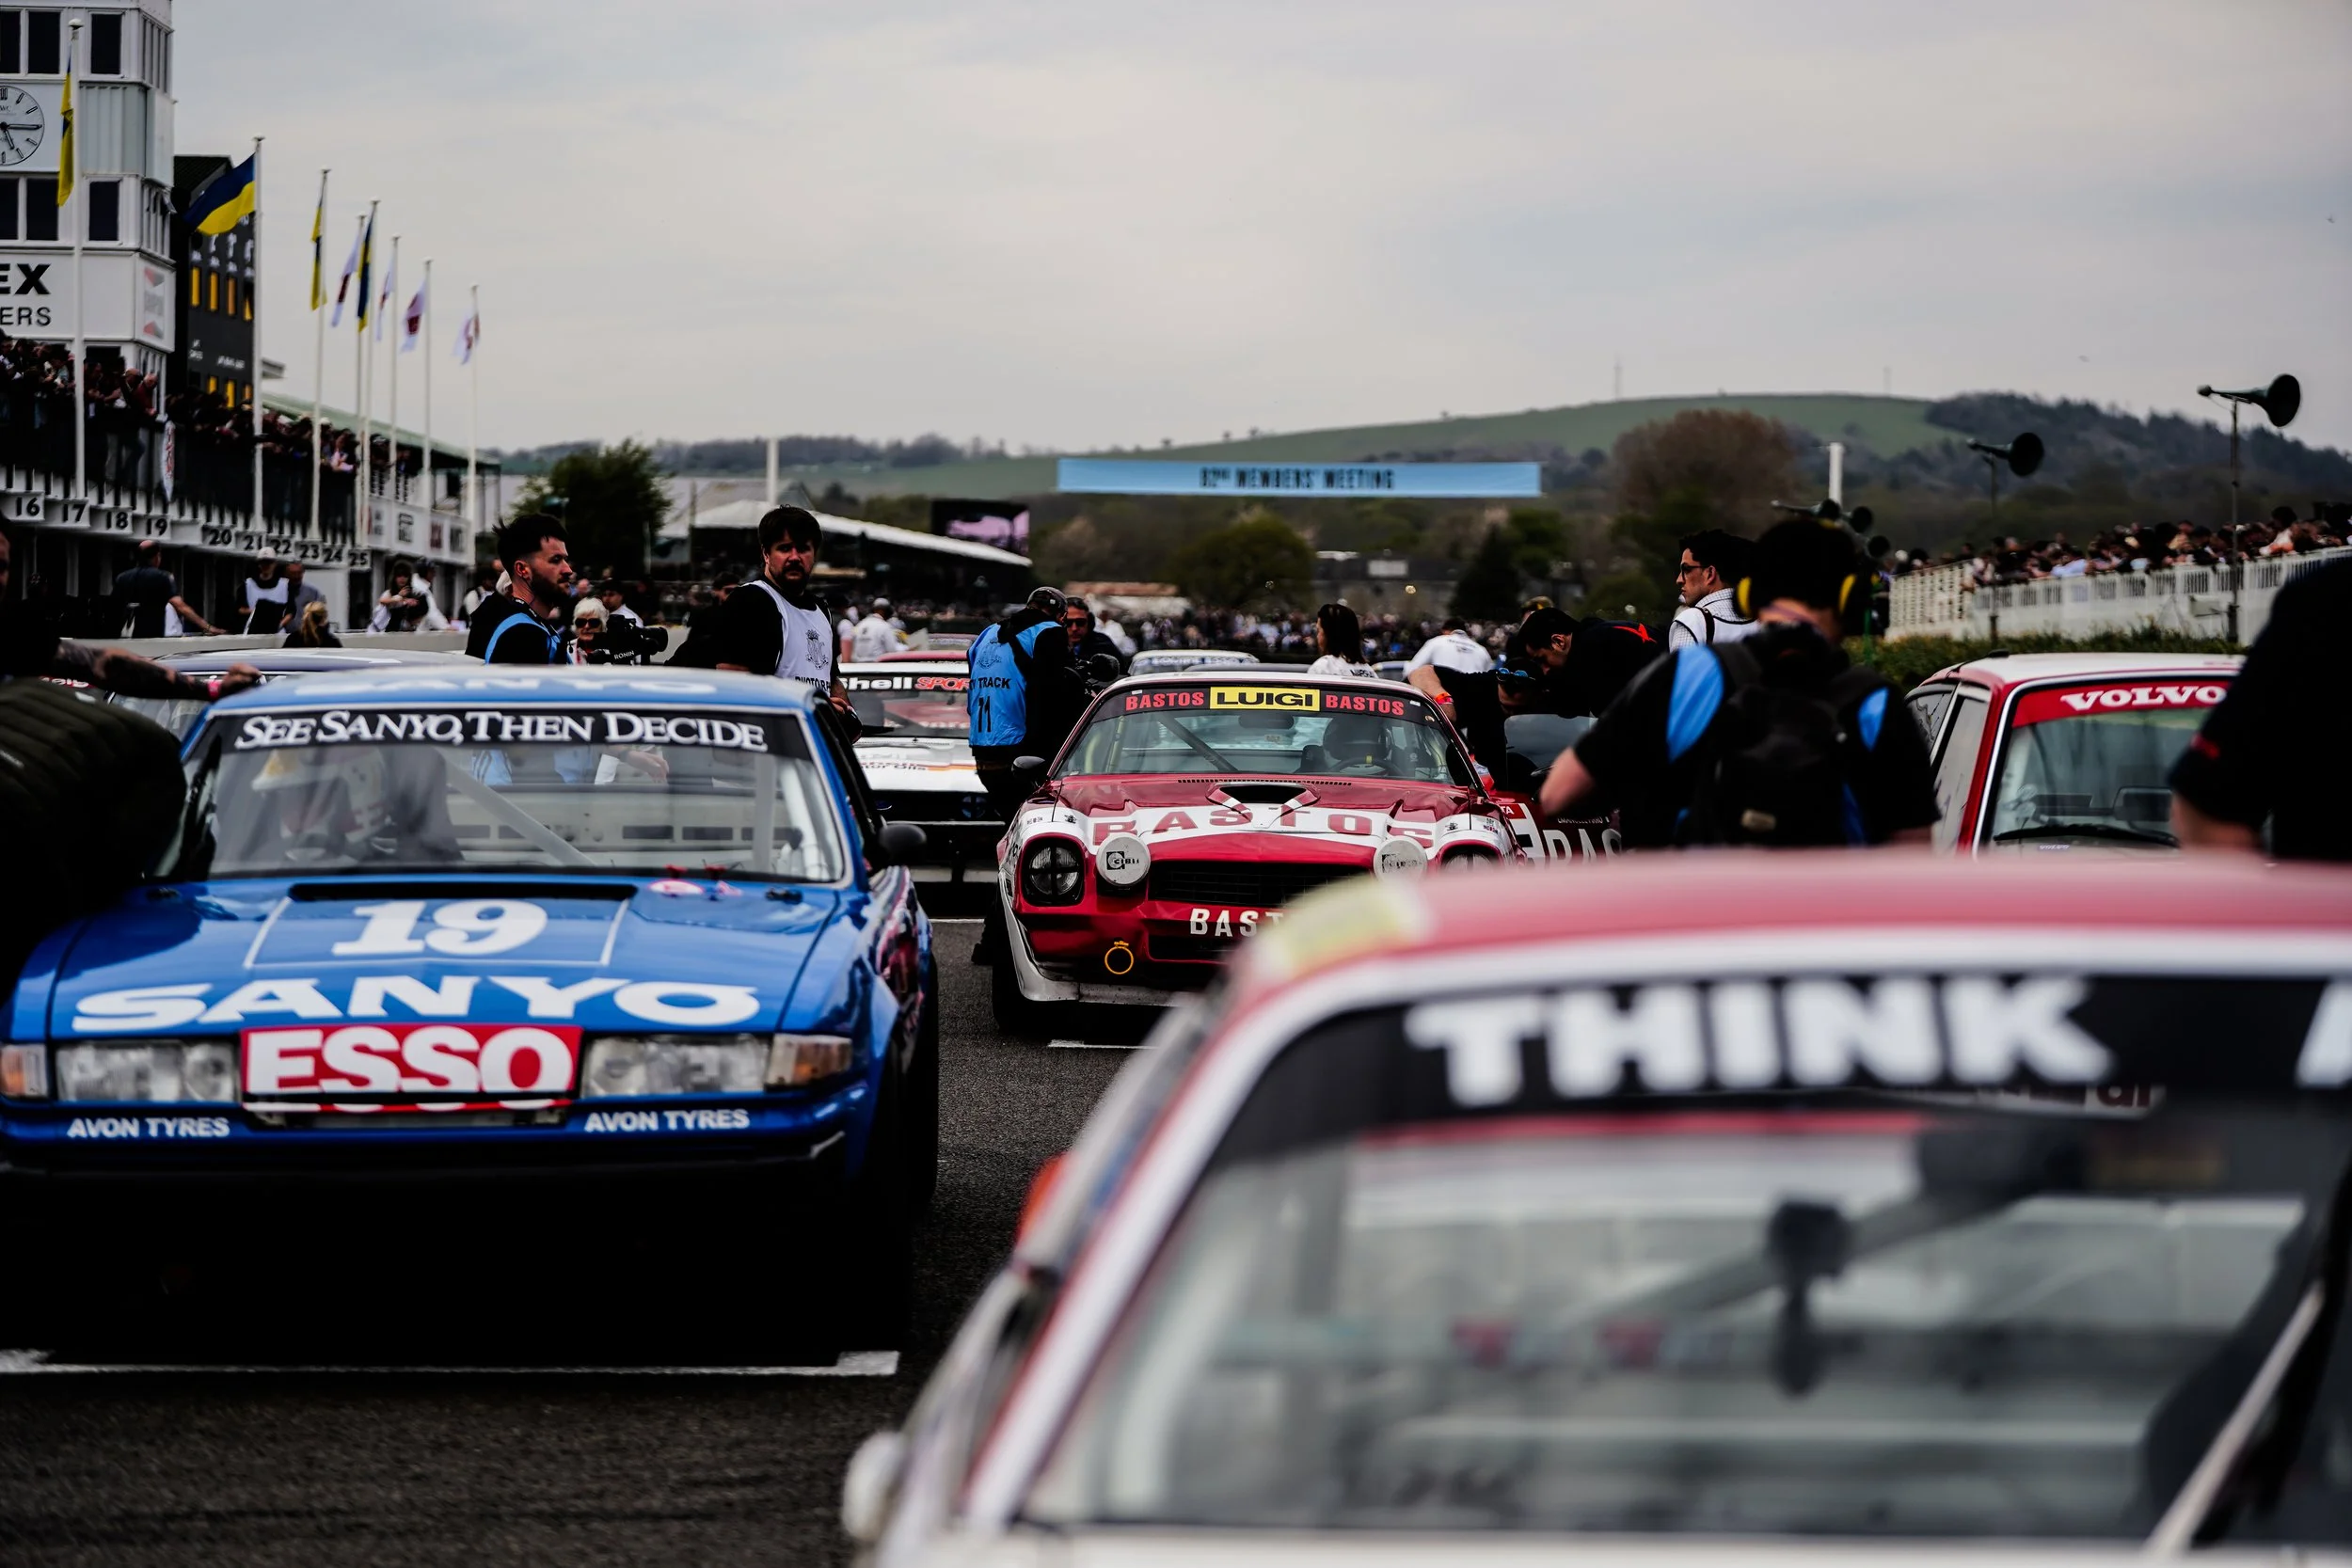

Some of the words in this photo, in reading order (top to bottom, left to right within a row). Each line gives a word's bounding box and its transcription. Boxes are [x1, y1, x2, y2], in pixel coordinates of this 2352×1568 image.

[15, 497, 40, 516] 16
[63, 504, 87, 523] 17
[106, 511, 129, 530] 18
[146, 517, 168, 536] 19
[209, 529, 233, 546] 20
[244, 535, 263, 551] 21
[271, 539, 292, 554] 22
[300, 544, 320, 560] 23
[323, 547, 343, 563] 24
[349, 551, 368, 566] 25
[613, 650, 635, 660] RONIN
[977, 677, 1012, 689] TRACK
[1125, 691, 1205, 711] BASTOS
[1216, 691, 1313, 707] LUIGI
[1325, 694, 1405, 716] BASTOS
[2060, 686, 2227, 711] VOLVO
[234, 716, 317, 749] SEE
[464, 711, 596, 742] THEN
[601, 712, 769, 752] DECIDE
[332, 899, 548, 958] 19
[1190, 908, 1284, 938] BAST
[72, 974, 760, 1032] SANYO
[1403, 973, 2117, 1106] THINK
[246, 1025, 573, 1094] ESSO
[66, 1117, 140, 1138] AVON
[144, 1117, 230, 1138] TYRES
[584, 1111, 659, 1132] AVON
[663, 1109, 751, 1131] TYRES
